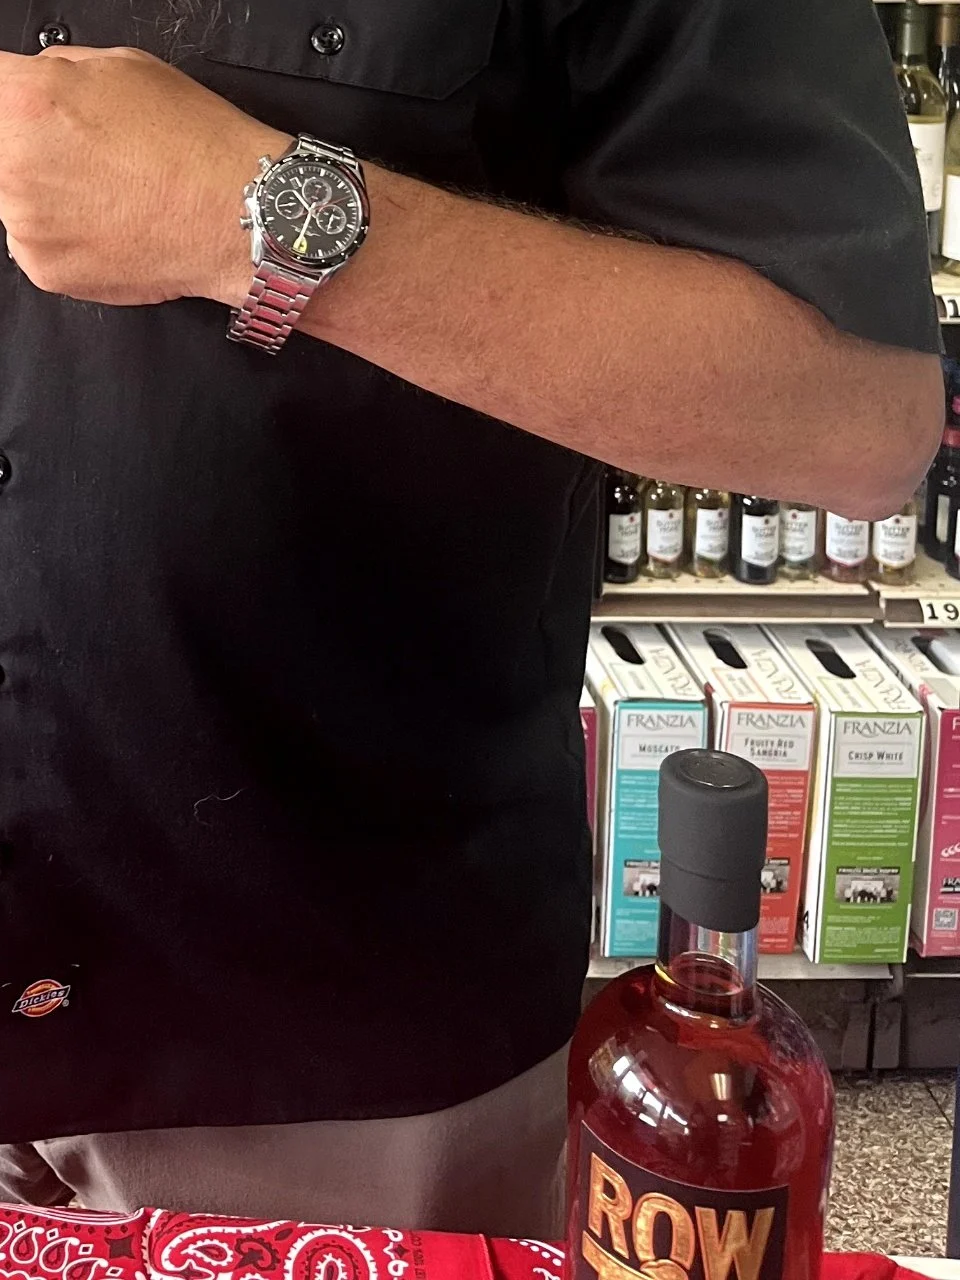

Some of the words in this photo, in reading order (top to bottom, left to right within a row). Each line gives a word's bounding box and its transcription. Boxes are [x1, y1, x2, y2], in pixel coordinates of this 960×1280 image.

[627, 713, 697, 731] FRANZIA
[737, 712, 806, 730] FRANZIA
[843, 721, 912, 738] FRANZIA
[744, 737, 774, 747] FRUITY
[777, 738, 795, 749] RED
[750, 747, 788, 758] SANGRIA
[848, 750, 873, 761] CRISP
[876, 750, 904, 761] WHITE
[18, 989, 66, 1010] Dickies
[589, 1151, 776, 1280] ROW
